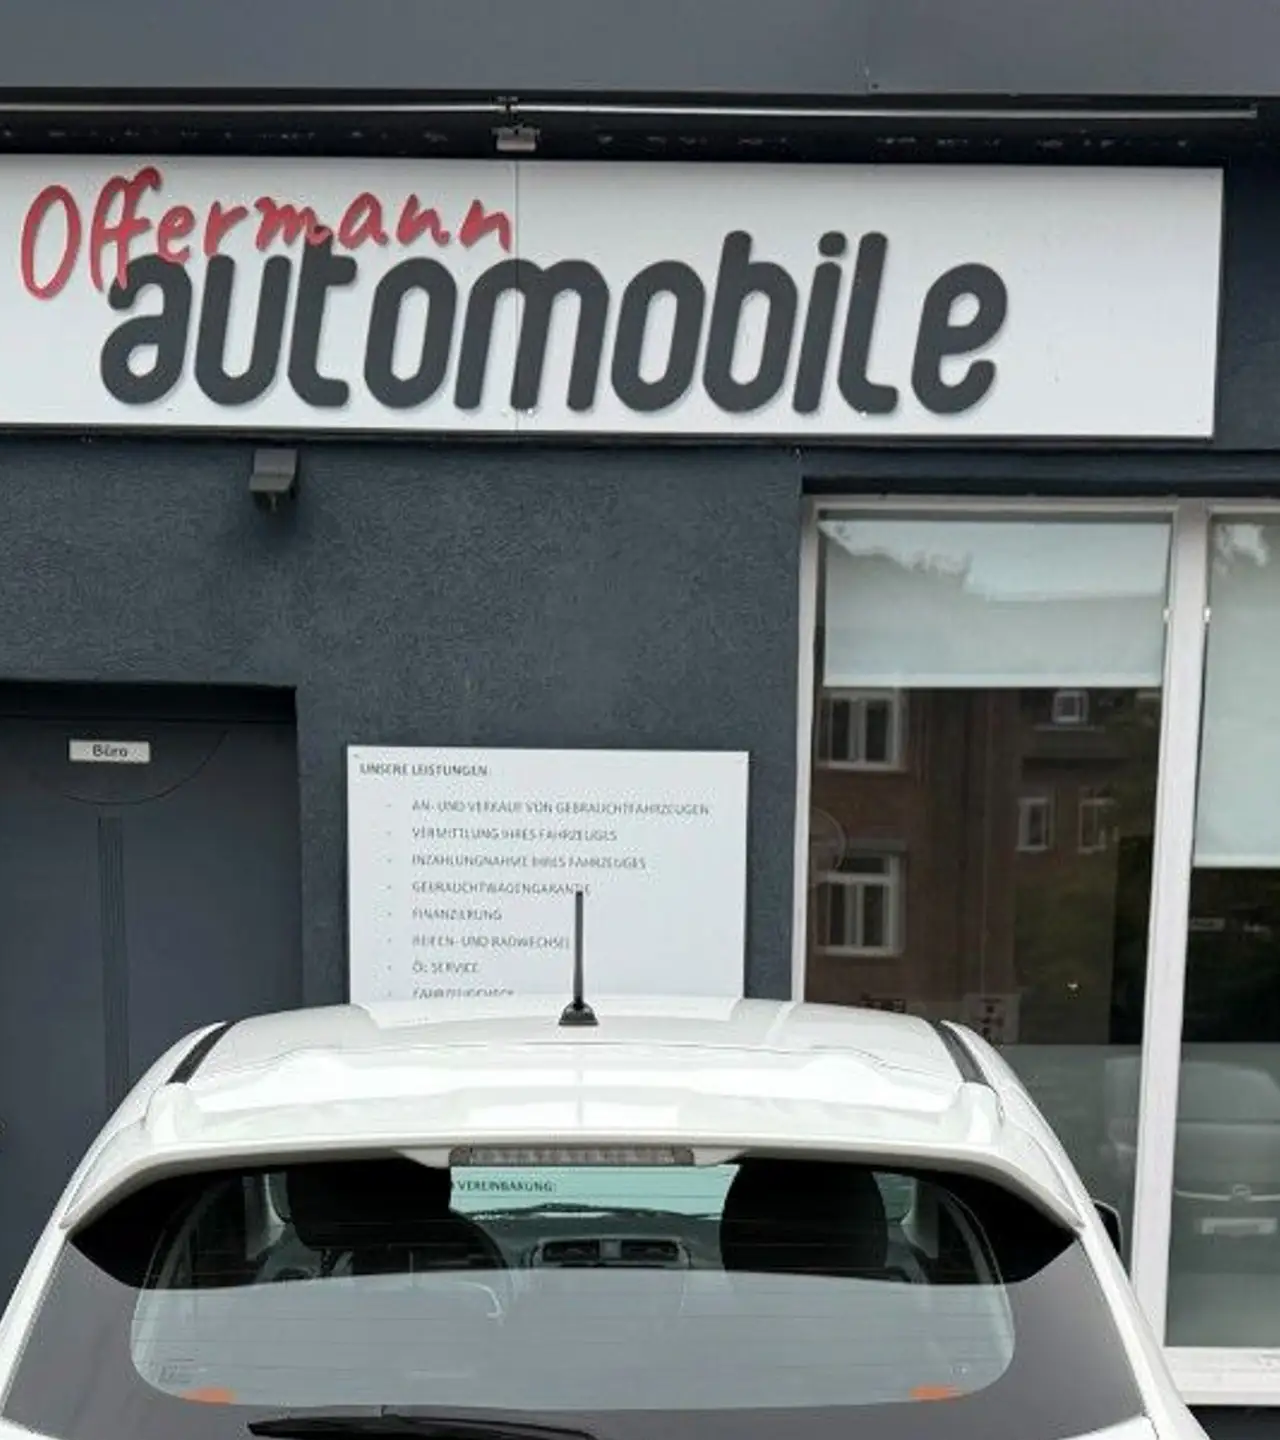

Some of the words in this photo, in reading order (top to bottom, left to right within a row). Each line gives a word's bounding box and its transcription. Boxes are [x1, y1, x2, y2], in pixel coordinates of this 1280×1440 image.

[19, 168, 517, 301] Offermann
[99, 229, 1010, 416] automobile
[93, 744, 128, 757] Büro
[359, 763, 408, 776] UNSERE
[438, 801, 466, 812] UND
[469, 801, 522, 813] VERKAUF
[525, 801, 552, 814] VON
[412, 827, 499, 840] VERMITTLUNG
[501, 828, 537, 841] IHRES
[540, 829, 618, 842] FAHRZEUGES
[532, 856, 566, 868] IHRES
[569, 856, 646, 869] FAHRZEUGES
[412, 909, 502, 921] FINANZIERUNG
[462, 936, 489, 948] UND
[431, 961, 479, 973] SERVICE
